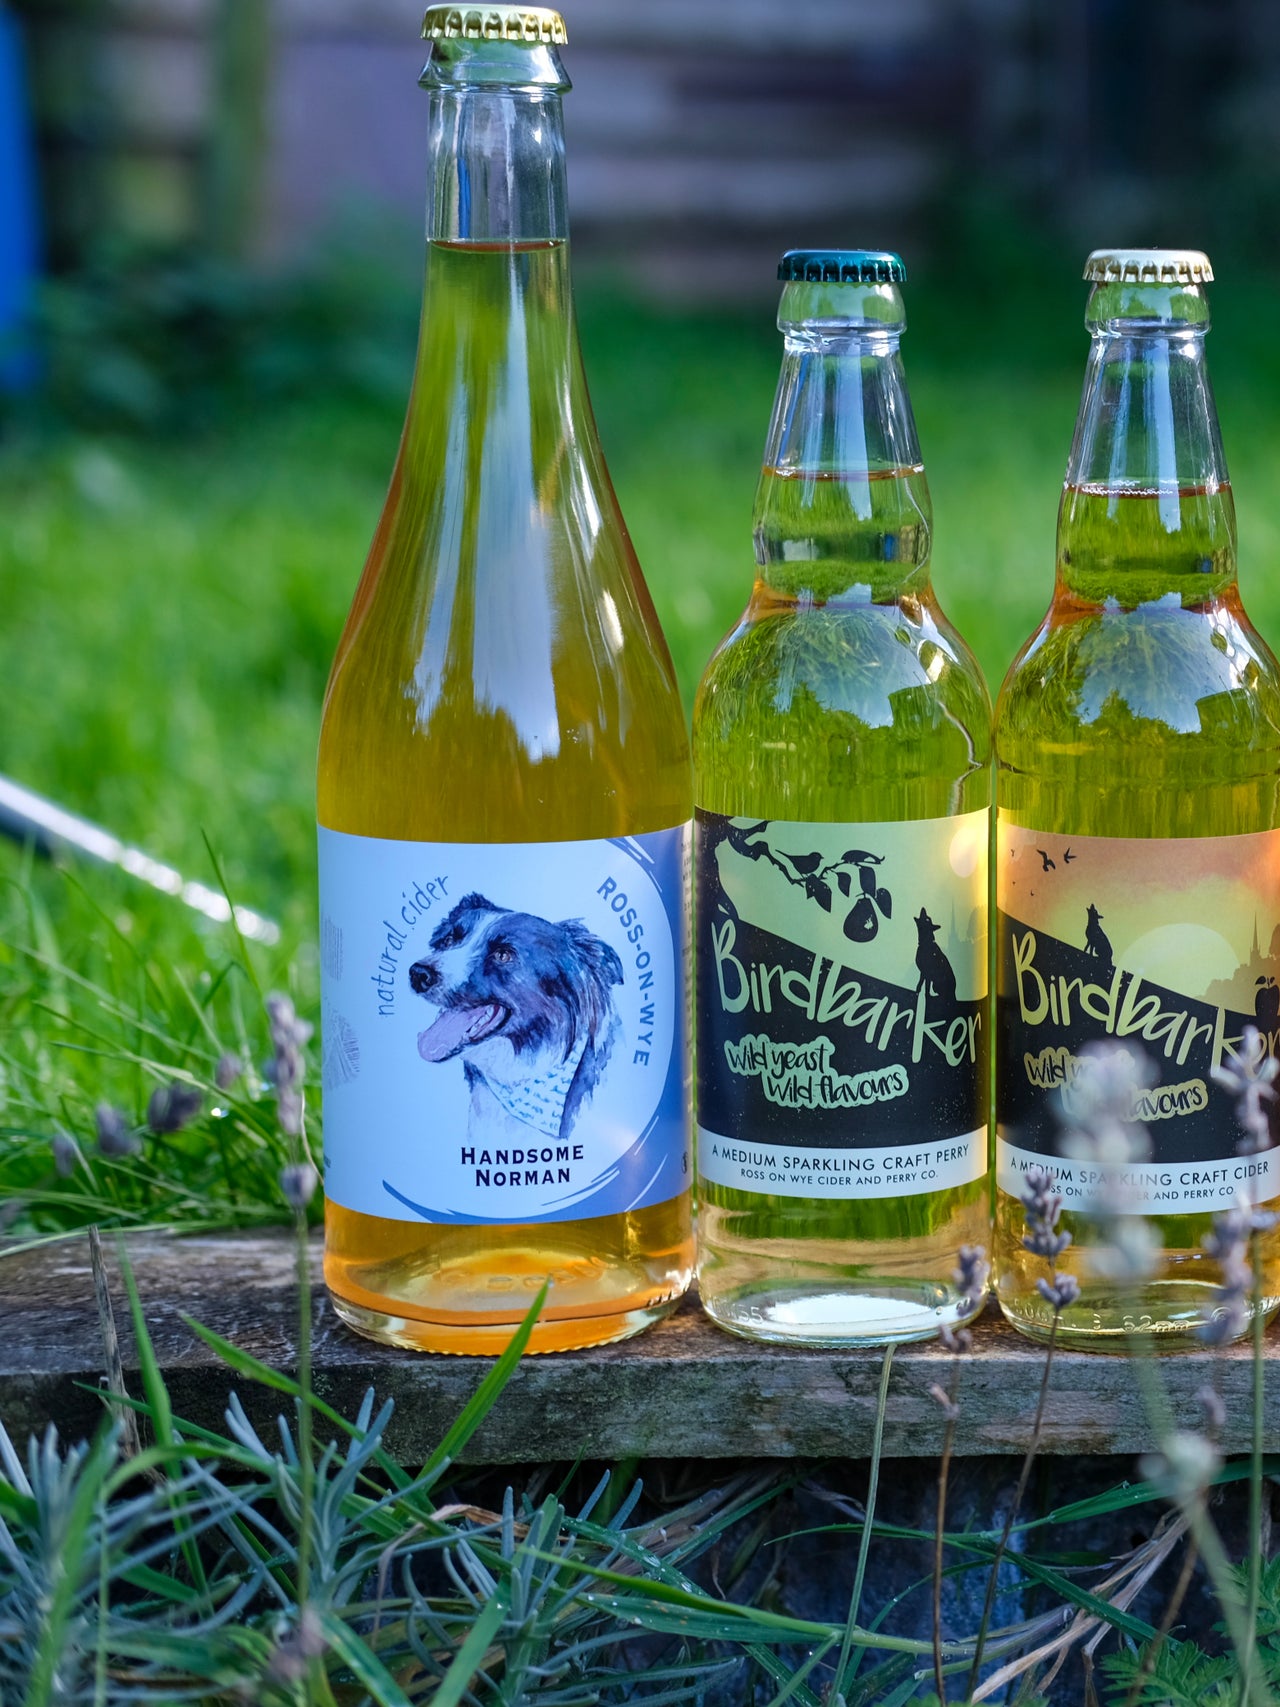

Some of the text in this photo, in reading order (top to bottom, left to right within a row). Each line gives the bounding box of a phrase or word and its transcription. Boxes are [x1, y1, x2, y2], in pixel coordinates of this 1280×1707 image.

[371, 875, 449, 1016] natural cider
[596, 875, 656, 1067] ROSS-ON-WYE
[711, 918, 982, 1067] Birdbarker
[771, 1043, 829, 1079] yeast
[767, 1070, 905, 1103] Wild flavours
[461, 1144, 585, 1165] HANDSOME
[711, 1143, 970, 1172] A MEDIUM SPARKLING CRAFT PERRY
[475, 1167, 571, 1187] NORMAN
[740, 1168, 939, 1186] ROSS ON WYE CIDER AND PERRY CO.
[1010, 1157, 1017, 1169] A
[1079, 1170, 1172, 1187] SPAKLING
[1179, 1169, 1228, 1186] CRAFT
[1233, 1160, 1269, 1180] CIDER
[1065, 1187, 1083, 1197] ON
[1153, 1191, 1179, 1200] AND
[1183, 1188, 1215, 1200] PERRY
